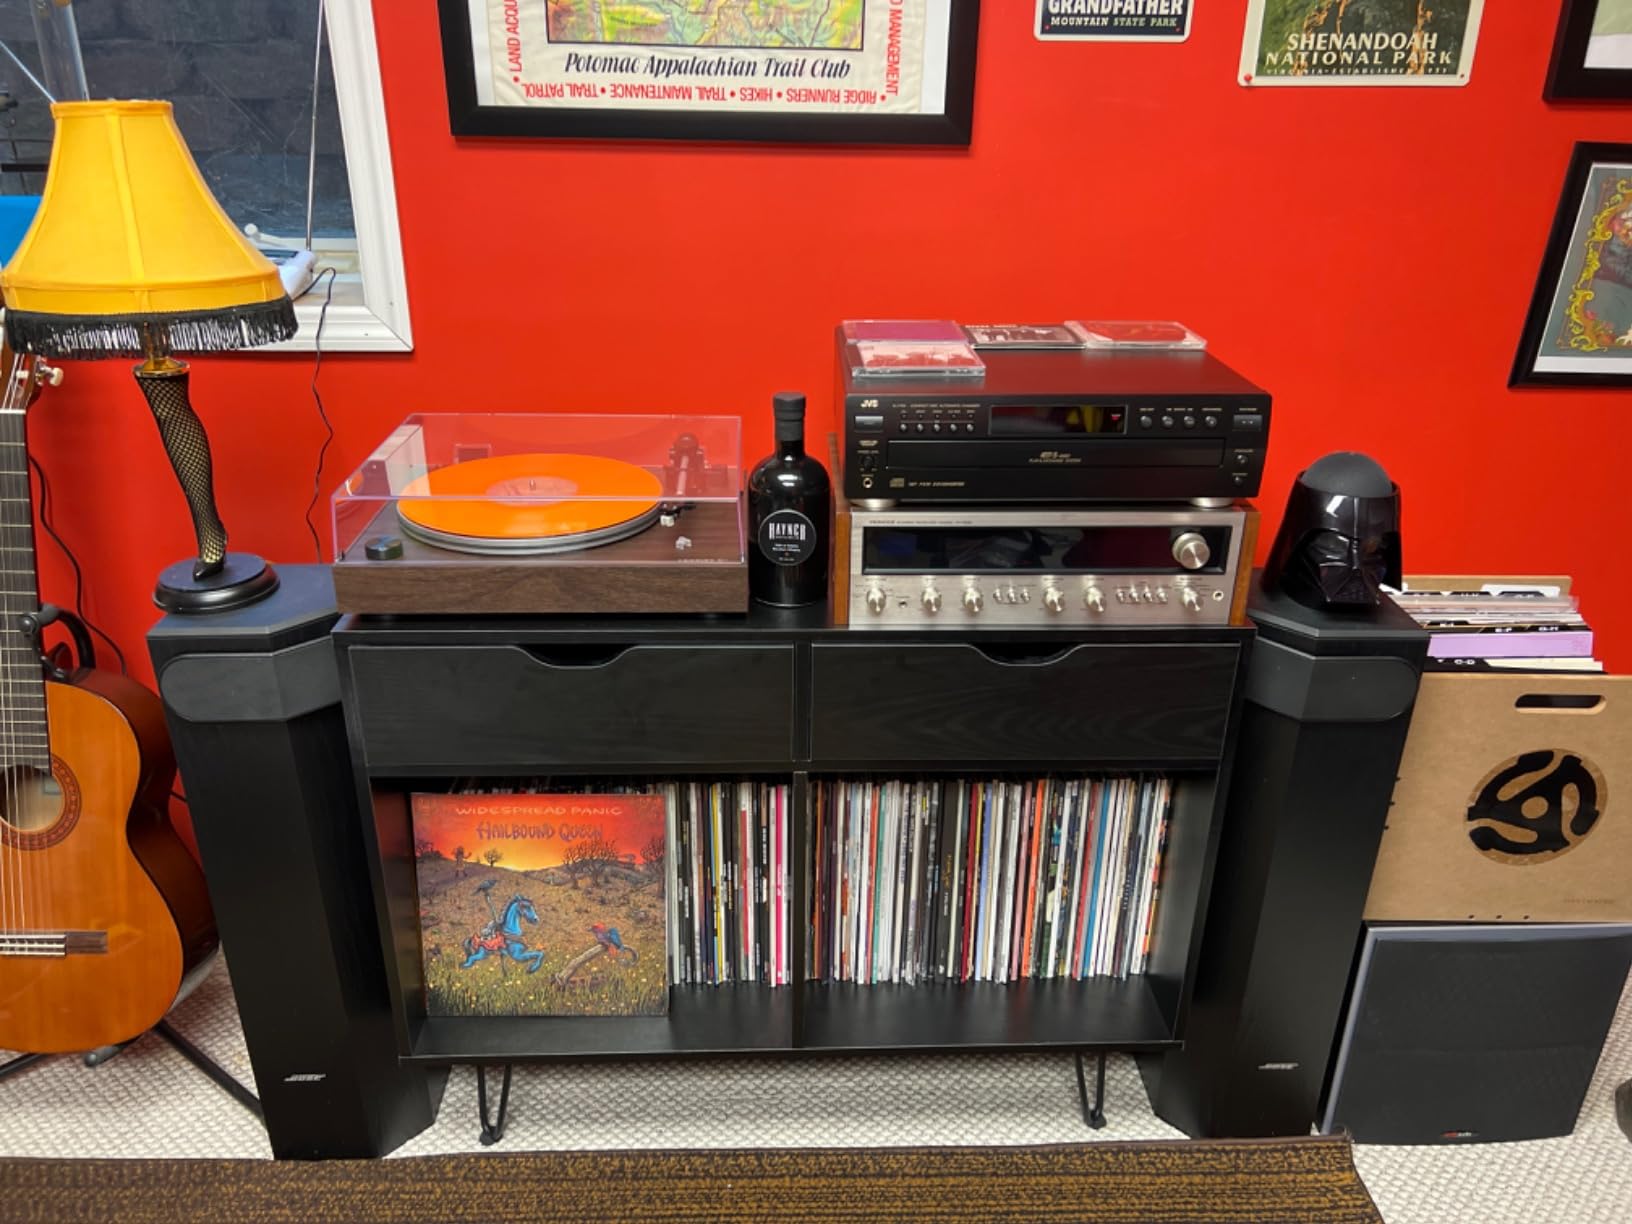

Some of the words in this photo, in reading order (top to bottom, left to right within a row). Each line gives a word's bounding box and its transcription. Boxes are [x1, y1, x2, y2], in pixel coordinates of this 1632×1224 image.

[1047, 0, 1183, 15] GRANDFATHER
[1050, 16, 1109, 26] MOUNTAIN
[1113, 17, 1146, 27] STATE
[1150, 17, 1177, 27] PARK
[1287, 32, 1438, 51] SHENANDOAH
[507, 37, 523, 73] LAND
[886, 9, 902, 96] MANAGEMENT
[1265, 51, 1384, 65] NATIONAL
[1392, 52, 1452, 65] PARK
[564, 52, 640, 73] Potomac
[643, 54, 758, 79] Appalachian
[764, 57, 806, 78] Trail
[810, 58, 852, 79] Club
[521, 82, 564, 98] PATROL
[565, 83, 599, 99] TRAIL
[609, 83, 692, 100] MAINTENANCE
[695, 86, 727, 101] TRAIL
[739, 87, 773, 101] HIKES
[786, 88, 841, 103] RUNNERS
[843, 89, 878, 104] RIDGE
[455, 806, 567, 816] WIDESPREAD
[571, 806, 624, 816] PANIC
